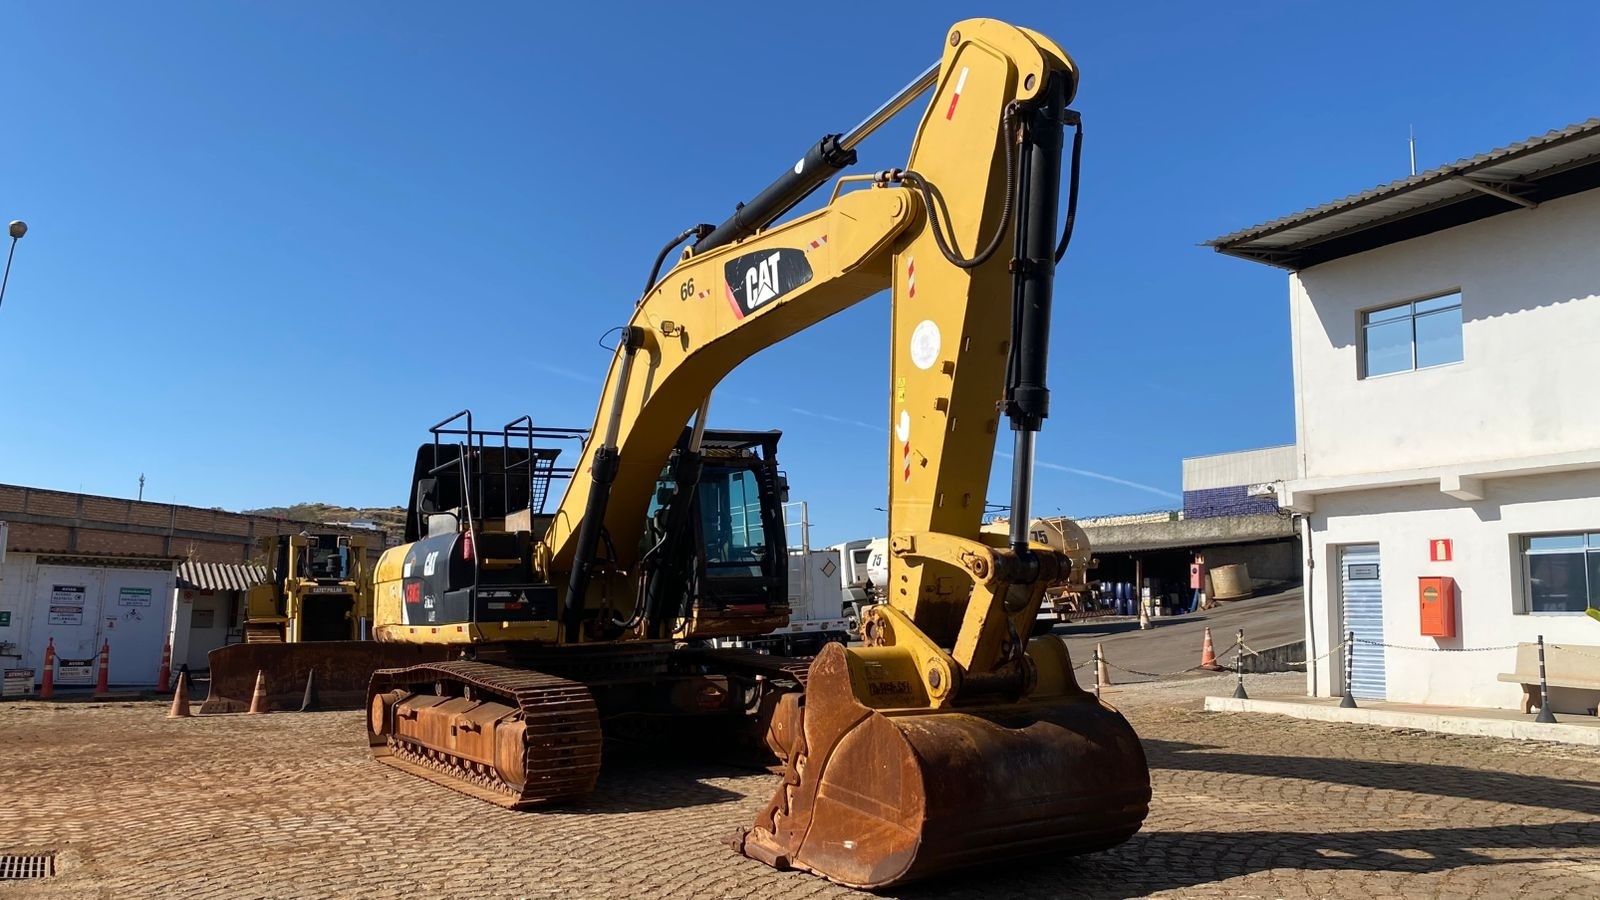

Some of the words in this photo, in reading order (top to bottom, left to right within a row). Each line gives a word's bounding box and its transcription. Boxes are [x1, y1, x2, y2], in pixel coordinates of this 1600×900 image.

[680, 277, 695, 301] 66
[745, 251, 780, 309] CAT
[1030, 530, 1048, 545] 75
[872, 553, 882, 566] 75
